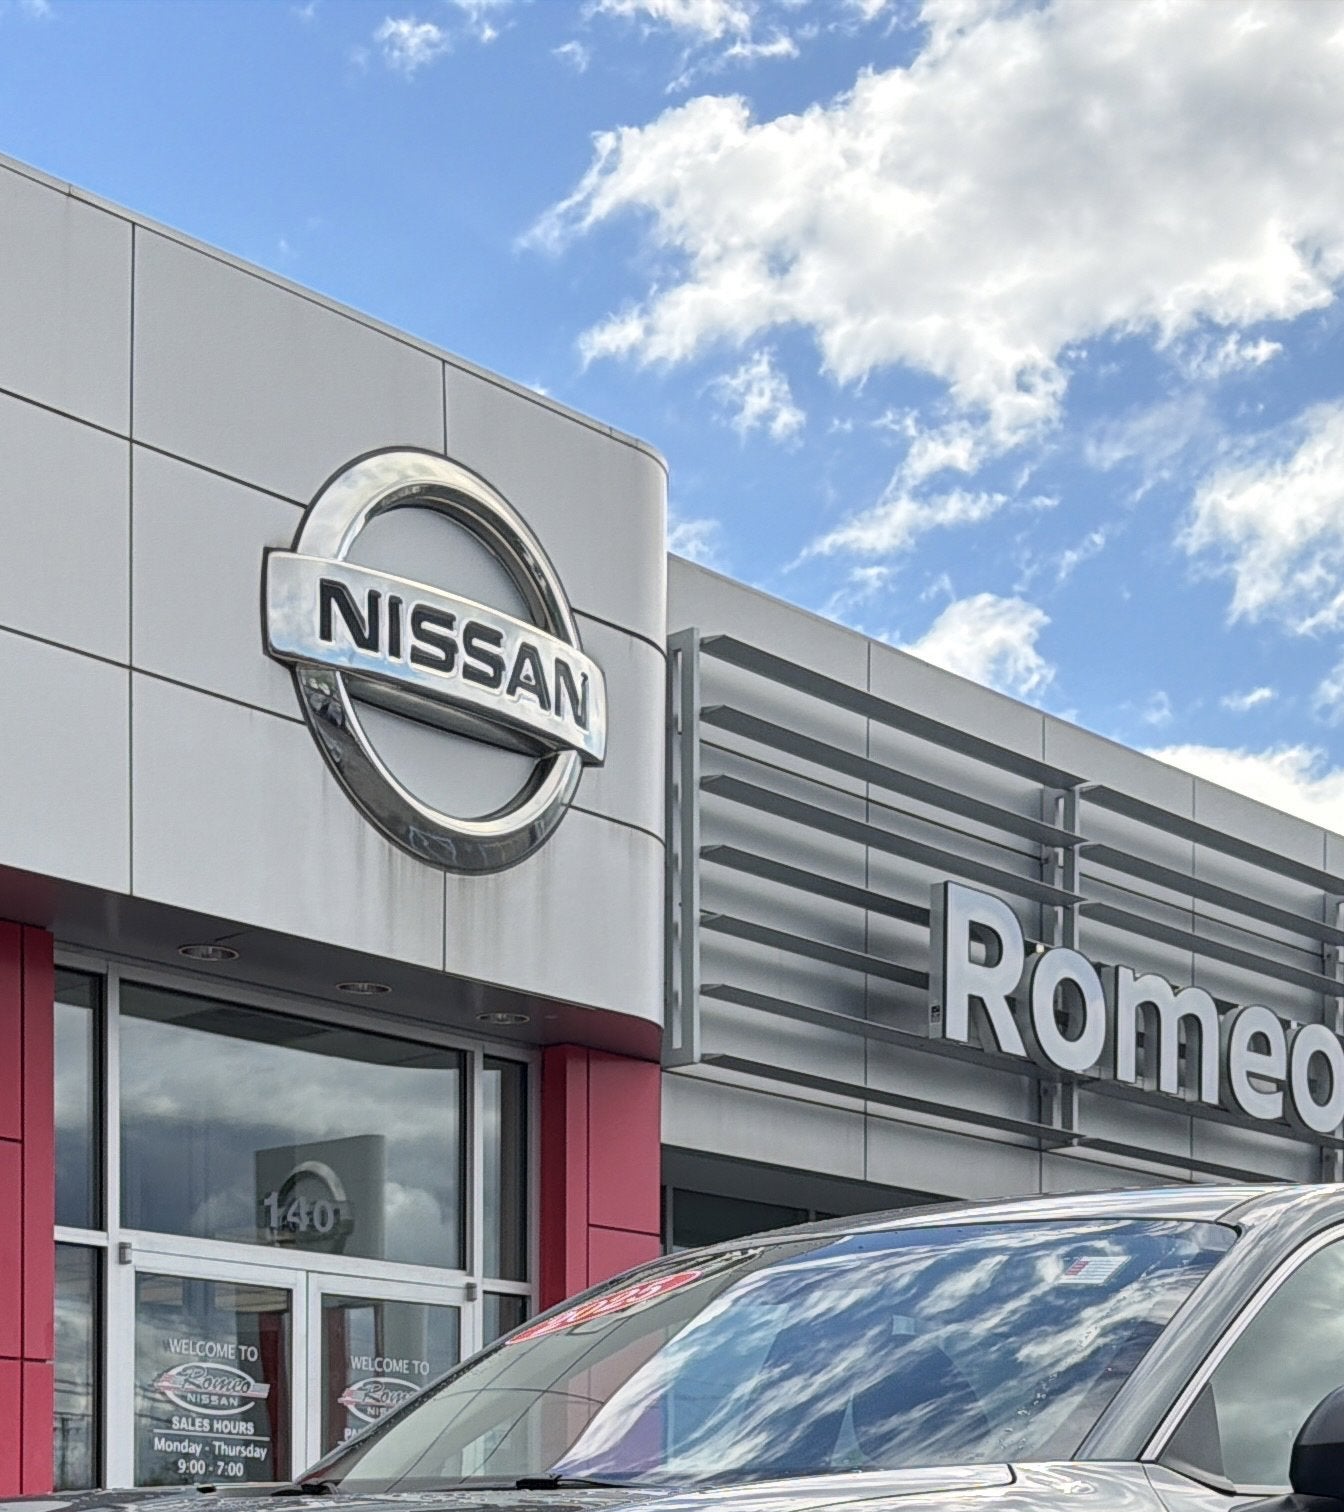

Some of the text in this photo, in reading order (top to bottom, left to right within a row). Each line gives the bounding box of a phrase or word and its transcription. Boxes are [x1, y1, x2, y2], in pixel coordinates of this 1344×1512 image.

[318, 576, 590, 732] NISSAN
[263, 1191, 335, 1233] 140
[168, 1338, 259, 1362] WELCOME TO
[350, 1355, 430, 1375] WELCOME TO
[176, 1365, 251, 1393] Romeo
[186, 1393, 239, 1407] NISSAN
[361, 1381, 414, 1404] Rom
[171, 1416, 255, 1435] SALES HOURS
[153, 1437, 203, 1457] Monday
[213, 1440, 268, 1461] Thursday
[177, 1459, 206, 1475] 9:00
[216, 1461, 244, 1476] 7:00
